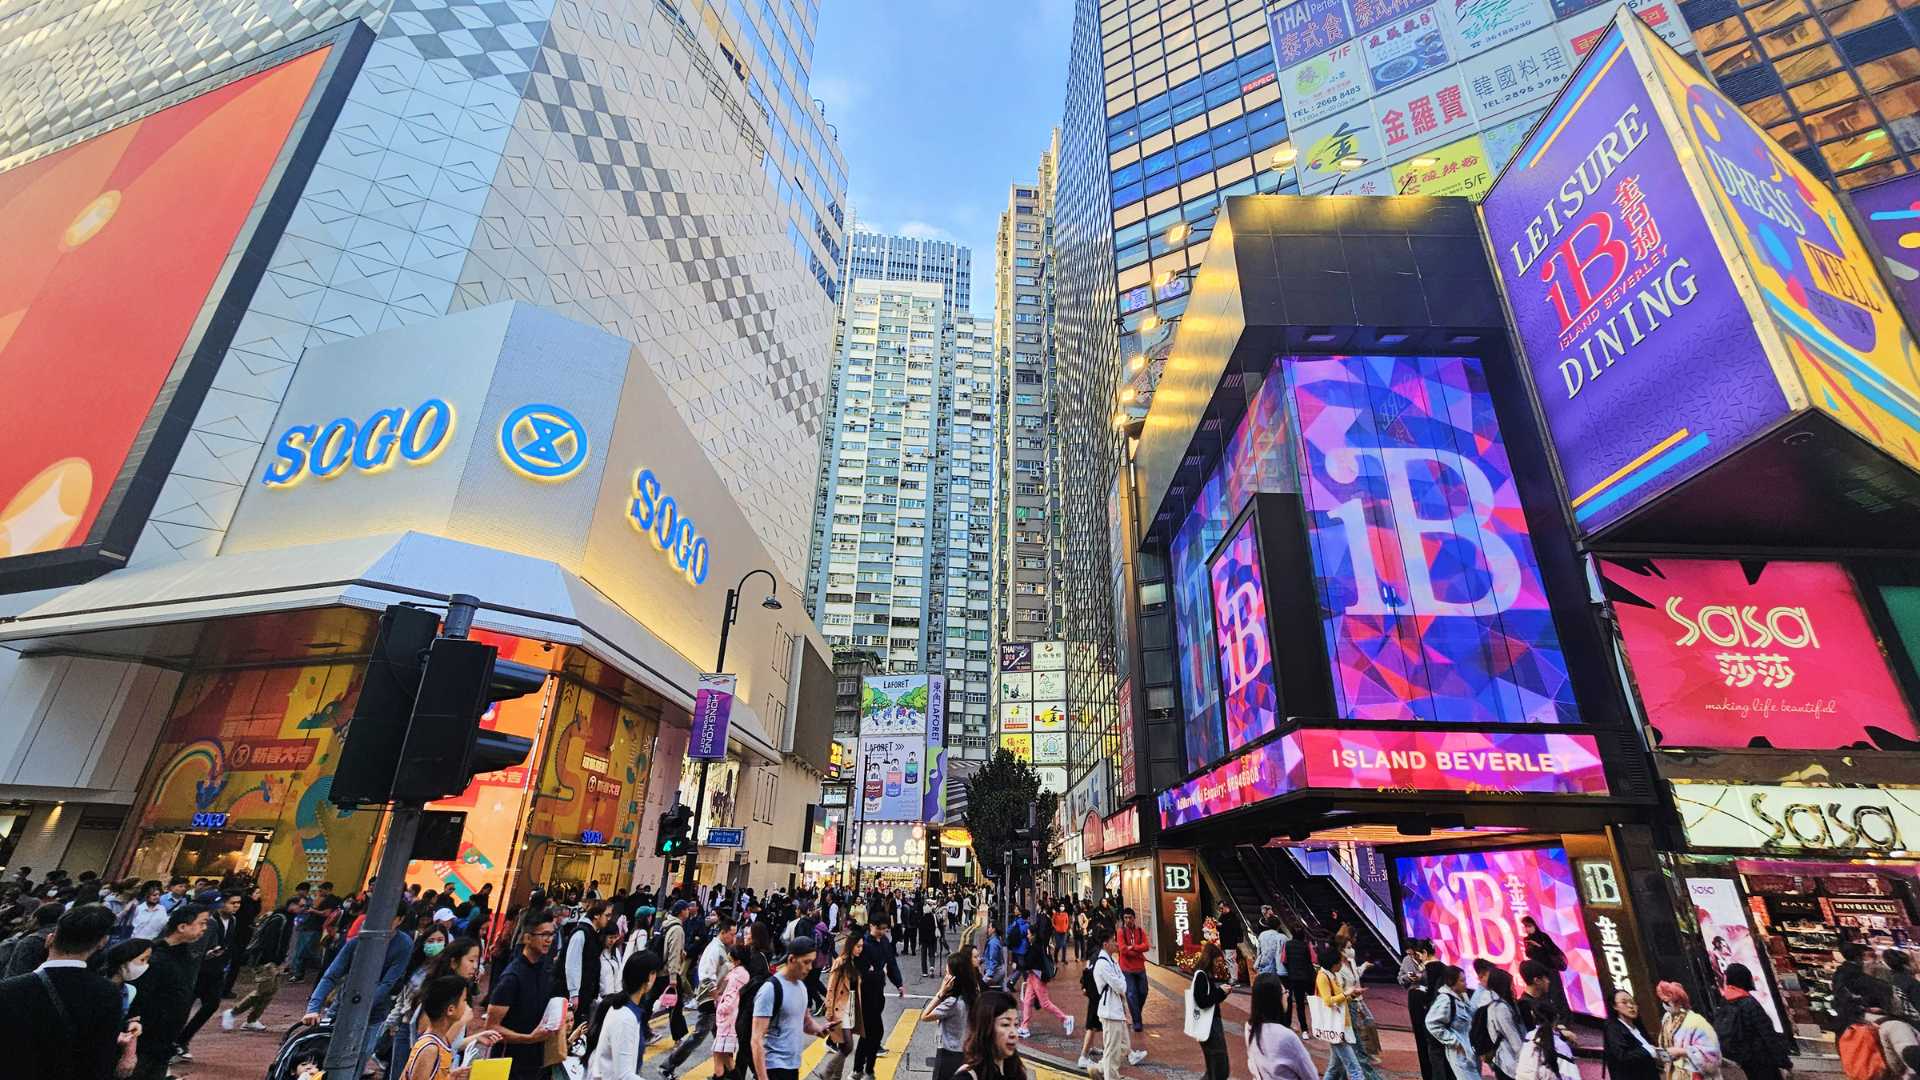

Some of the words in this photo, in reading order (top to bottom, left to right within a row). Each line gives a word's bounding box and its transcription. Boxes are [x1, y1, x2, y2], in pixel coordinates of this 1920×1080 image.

[1274, 2, 1311, 34] THAI
[1329, 45, 1351, 62] 7/F
[1472, 46, 1567, 99] 韓國料理
[1382, 84, 1467, 146] 金羅寶
[1464, 172, 1487, 190] 5/F
[1510, 104, 1649, 277] LEISURE
[1705, 145, 1806, 236] DRESS
[1559, 309, 1601, 352] ISLAND
[1603, 244, 1668, 310] BEVERLEY
[1558, 258, 1699, 400] DINING
[262, 398, 453, 487] SOGO
[630, 468, 709, 586] SOGO
[884, 679, 909, 689] LAFORET
[1715, 652, 1795, 689] 莎莎
[708, 694, 720, 723] HONG
[931, 703, 941, 741] LAFORET
[1705, 697, 1749, 718] making
[1752, 698, 1778, 718] life
[1781, 699, 1838, 720] beautiful
[703, 724, 715, 754] KONG
[1332, 748, 1426, 770] ISLAND
[1436, 751, 1574, 773] BEVERLEY
[192, 812, 226, 828] SOGO
[1166, 866, 1190, 890] iB
